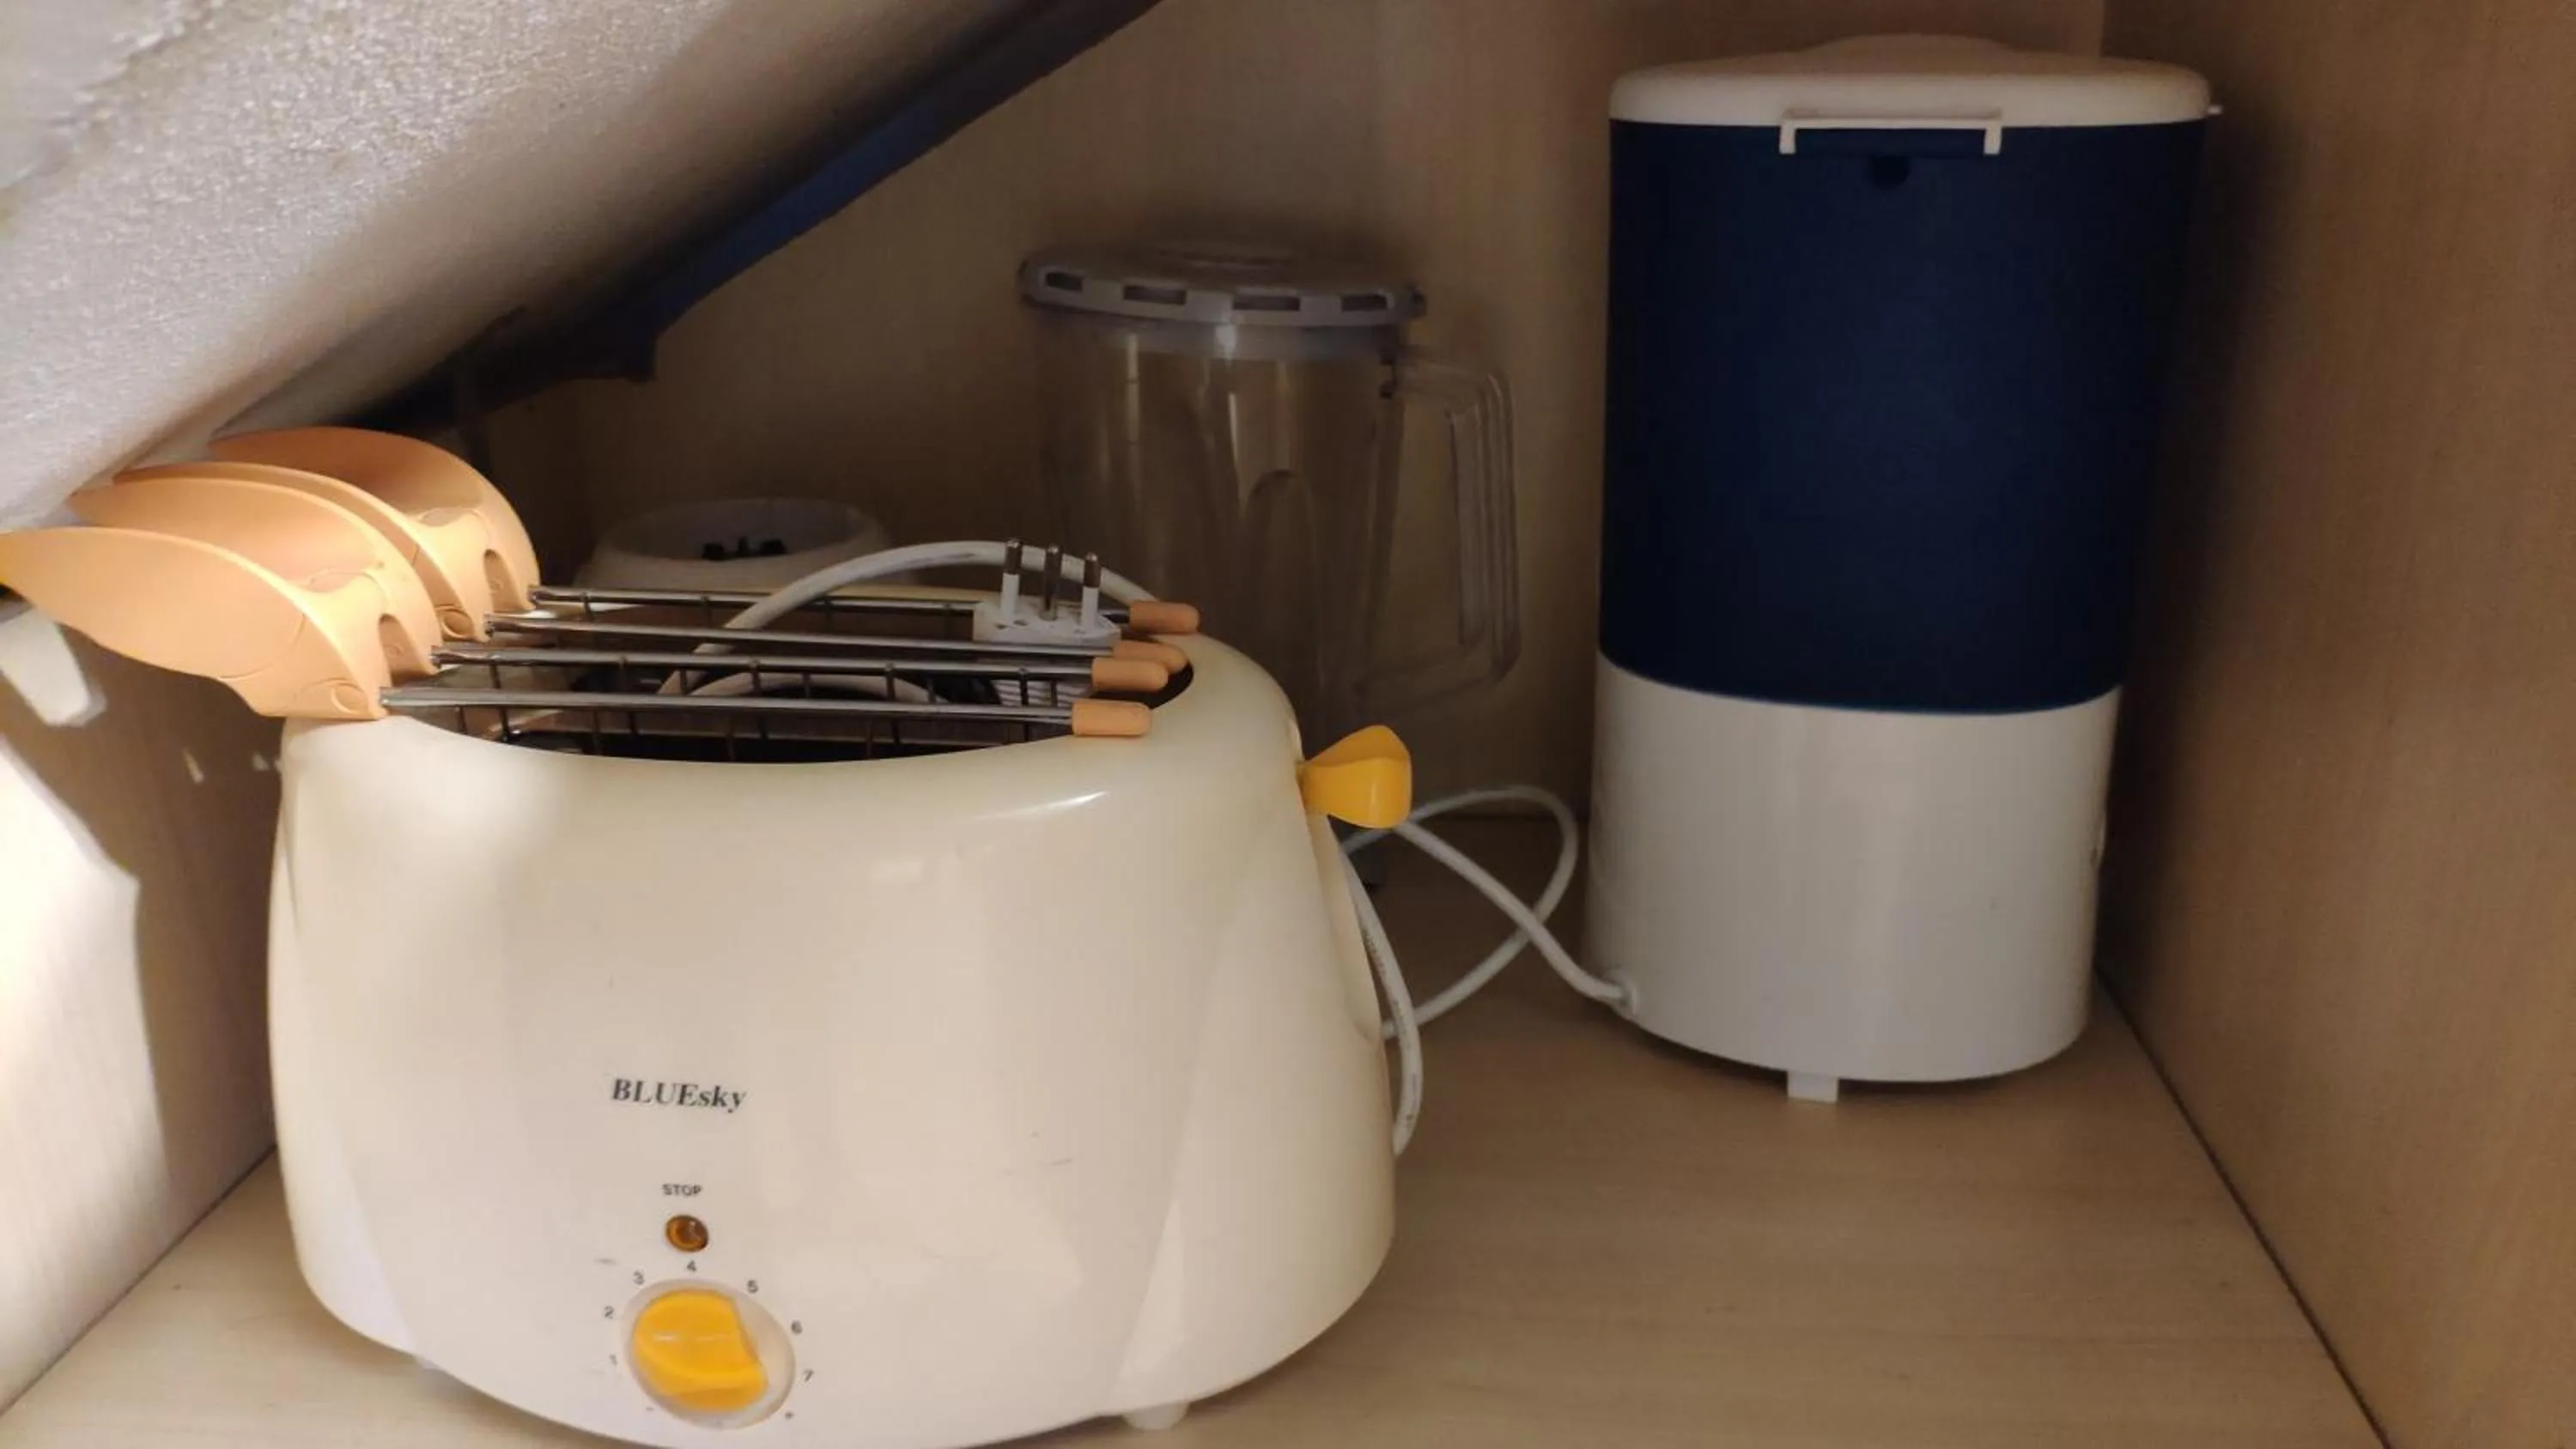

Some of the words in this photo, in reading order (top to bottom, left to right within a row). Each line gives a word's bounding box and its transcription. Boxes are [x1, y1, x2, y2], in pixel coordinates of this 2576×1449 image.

[611, 1077, 746, 1113] BLUEsky
[662, 1183, 702, 1197] STOP
[686, 1259, 697, 1273] 4
[633, 1270, 644, 1285] 3
[746, 1279, 759, 1294] 5
[604, 1305, 614, 1319] 2
[791, 1320, 803, 1334] 6
[609, 1354, 618, 1367] 1
[803, 1369, 815, 1382] 7
